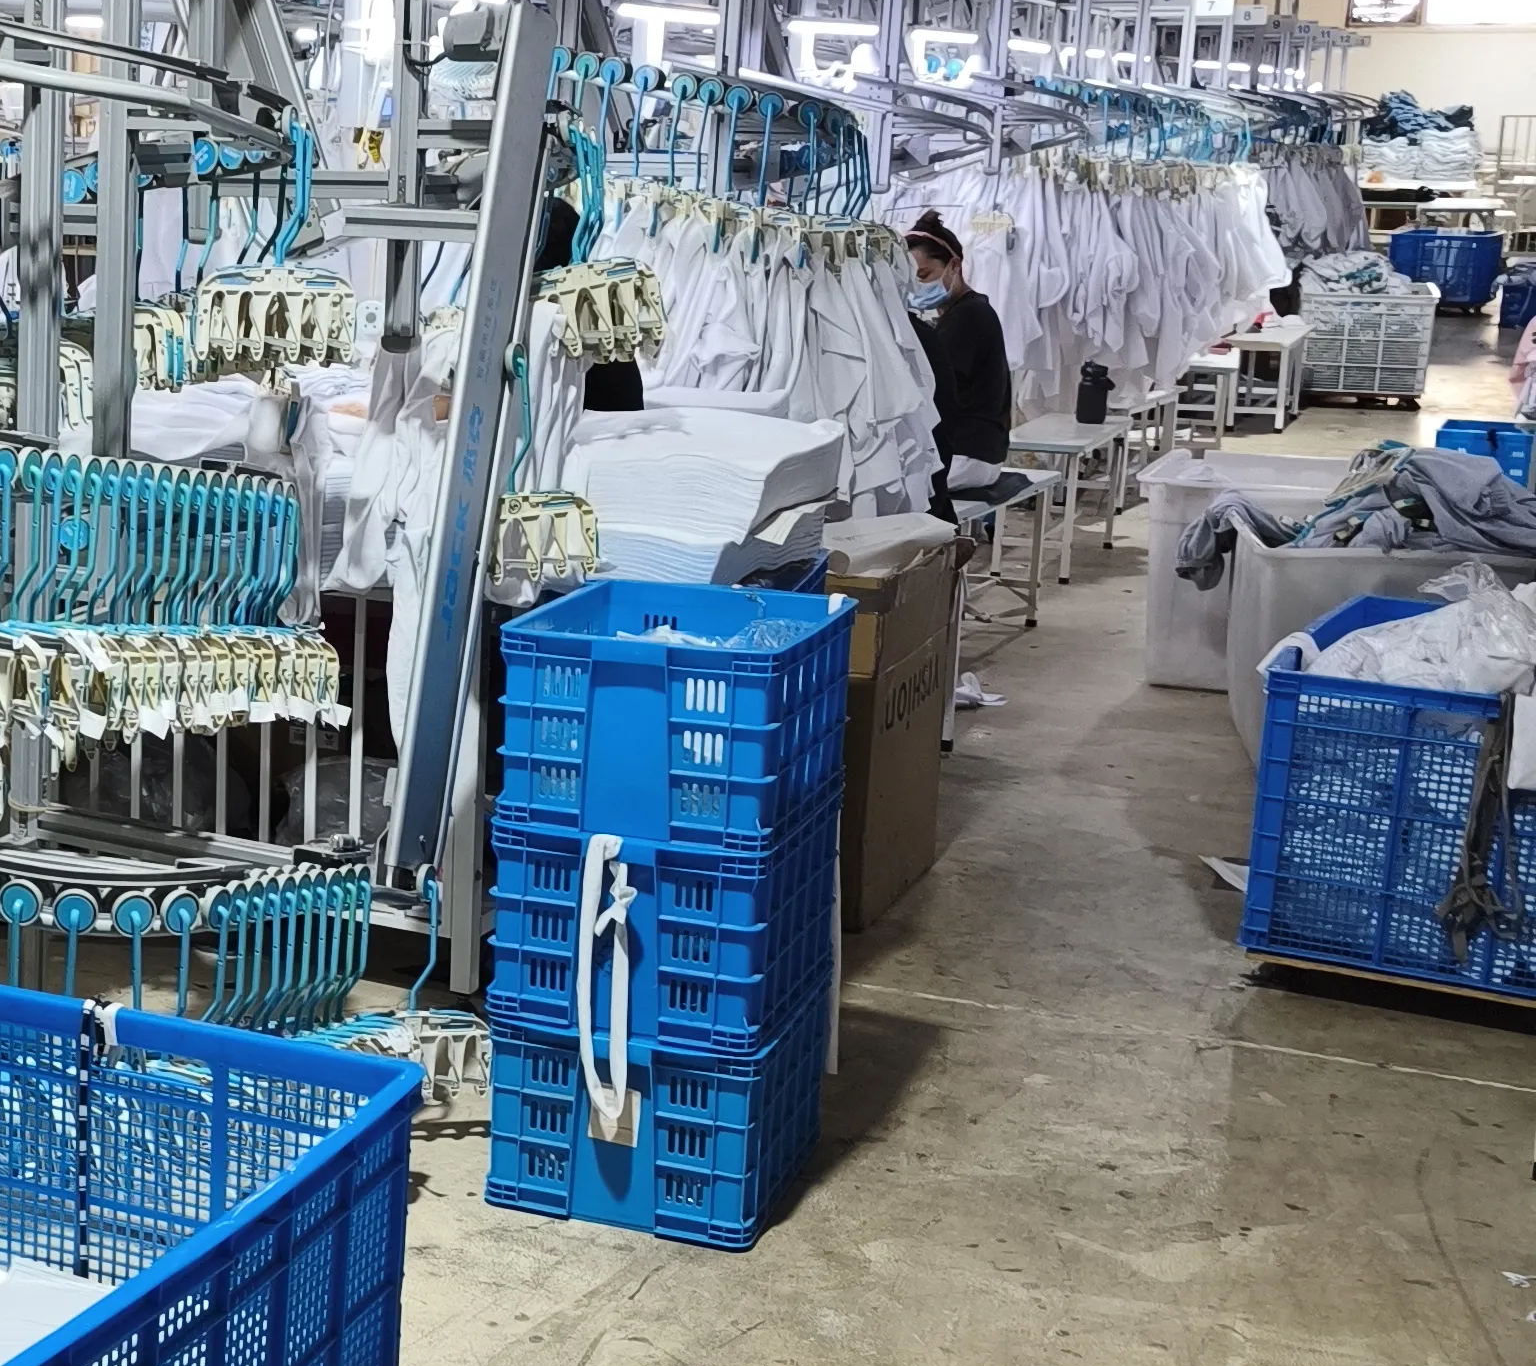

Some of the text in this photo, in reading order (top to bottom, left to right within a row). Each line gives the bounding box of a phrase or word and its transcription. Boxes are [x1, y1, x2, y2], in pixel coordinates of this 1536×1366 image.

[1207, 1, 1216, 12] 7
[1243, 10, 1252, 21] 8
[1272, 19, 1281, 30] 9
[1297, 24, 1311, 34] 10
[1320, 29, 1331, 39] 11
[1340, 35, 1351, 43] 12
